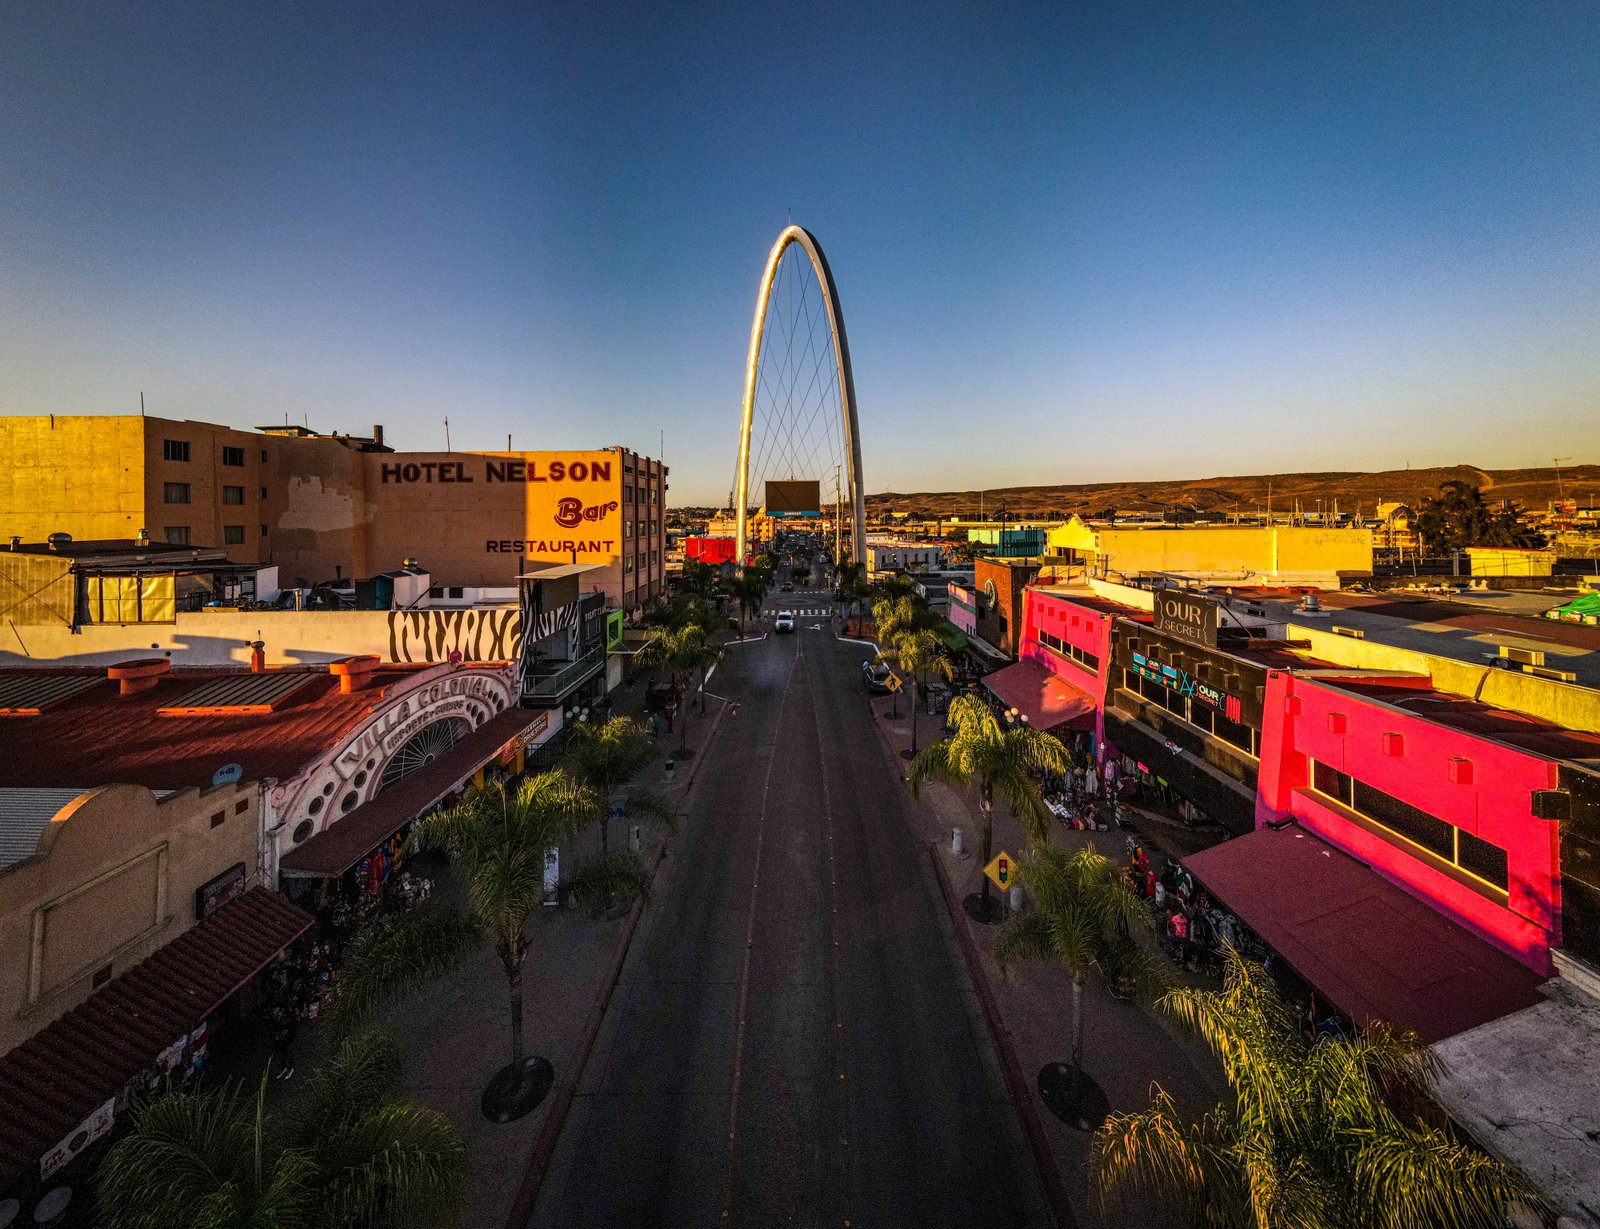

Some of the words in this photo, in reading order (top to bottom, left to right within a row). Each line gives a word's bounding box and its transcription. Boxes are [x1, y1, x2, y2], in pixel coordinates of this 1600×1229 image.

[381, 461, 473, 484] HOTEL
[486, 460, 611, 483] NELSON
[553, 496, 618, 529] Bar
[486, 540, 614, 553] RESTAURANT
[1165, 600, 1202, 625] OUR
[1165, 619, 1202, 639] SECRET
[1198, 685, 1220, 702] OUR
[1198, 693, 1219, 707] SECRET
[343, 701, 411, 765] VILLA
[418, 677, 489, 709] COLONIAL
